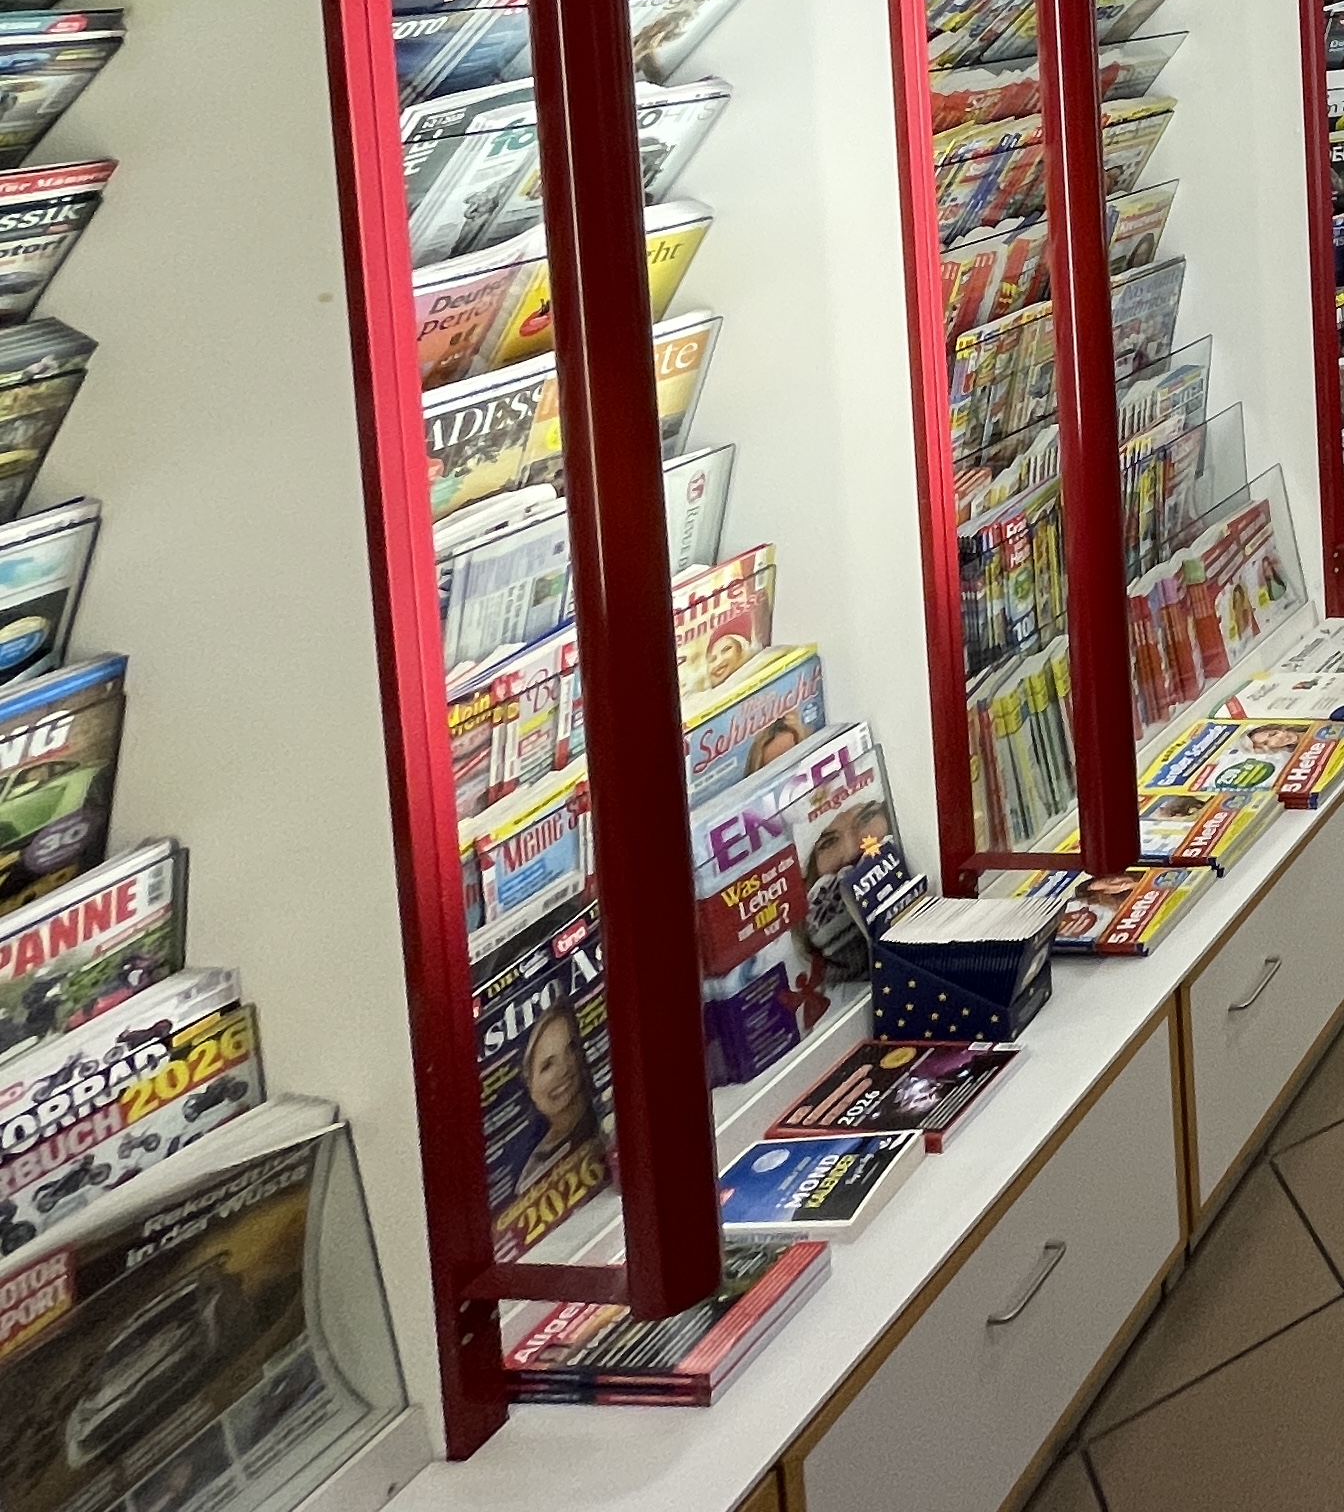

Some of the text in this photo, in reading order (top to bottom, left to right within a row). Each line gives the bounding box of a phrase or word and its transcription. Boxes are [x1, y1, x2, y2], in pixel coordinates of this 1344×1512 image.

[1286, 741, 1326, 781] Hefte
[721, 874, 761, 908] Was
[738, 877, 788, 920] Leben
[852, 853, 900, 902] ASTRAL
[1118, 888, 1162, 931] Hefte
[124, 1023, 254, 1126] 2026
[838, 1091, 880, 1126] 2026
